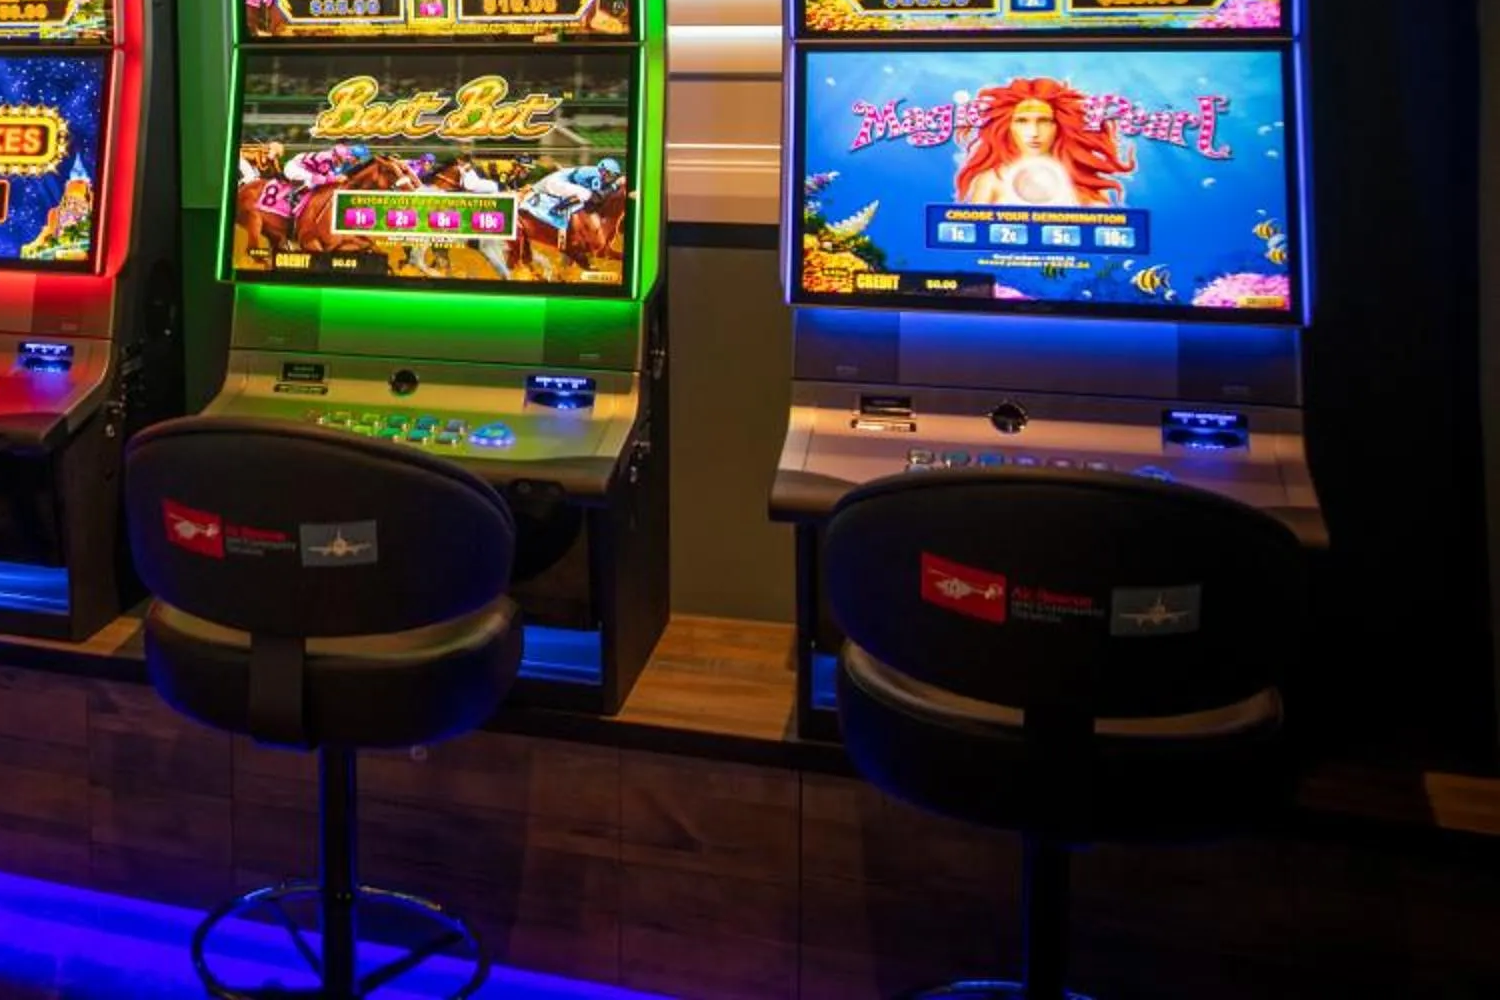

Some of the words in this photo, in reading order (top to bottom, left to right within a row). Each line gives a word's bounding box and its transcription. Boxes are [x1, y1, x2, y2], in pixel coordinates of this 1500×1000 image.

[312, 75, 450, 138] Best
[438, 75, 562, 138] Bet
[850, 90, 991, 152] Magic
[262, 185, 278, 206] 8
[946, 210, 993, 220] CHOOSE
